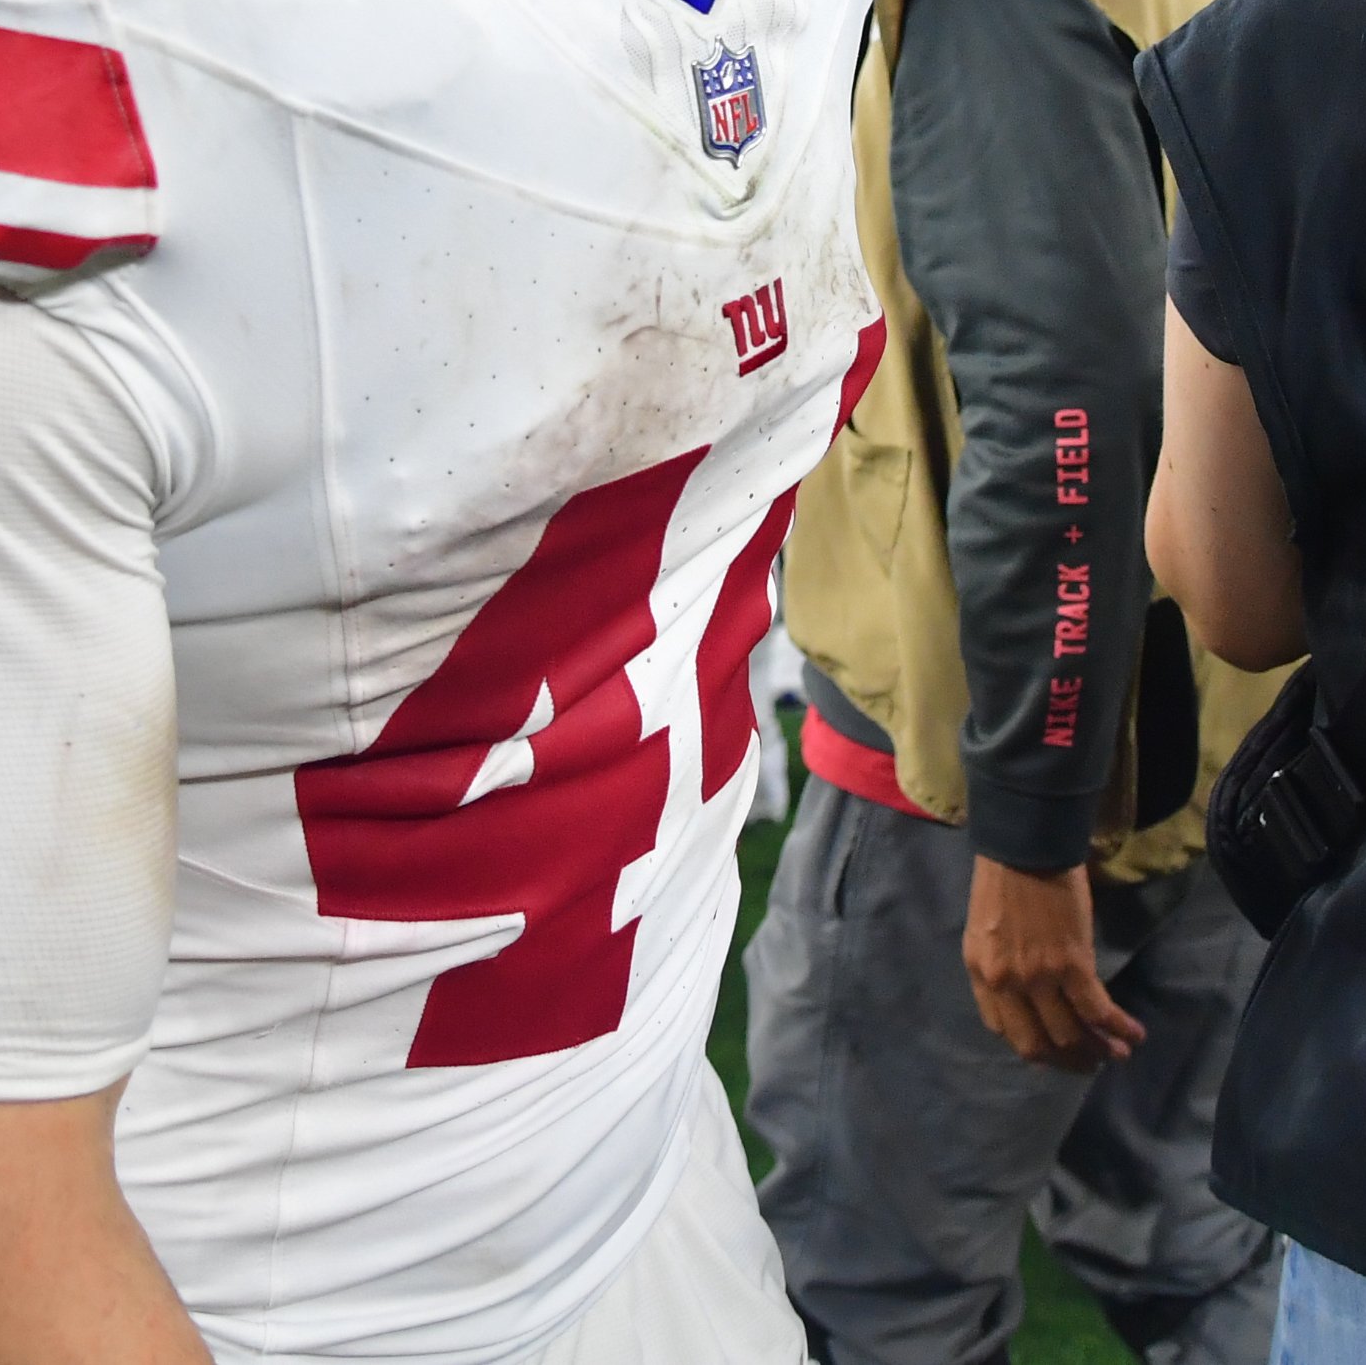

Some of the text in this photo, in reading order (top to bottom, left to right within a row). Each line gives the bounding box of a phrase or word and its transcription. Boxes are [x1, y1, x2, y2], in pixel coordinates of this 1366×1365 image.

[711, 93, 759, 144] NFL
[1054, 407, 1090, 506] FIELD
[1053, 563, 1091, 659] TRACK
[1043, 676, 1083, 748] NIKE
